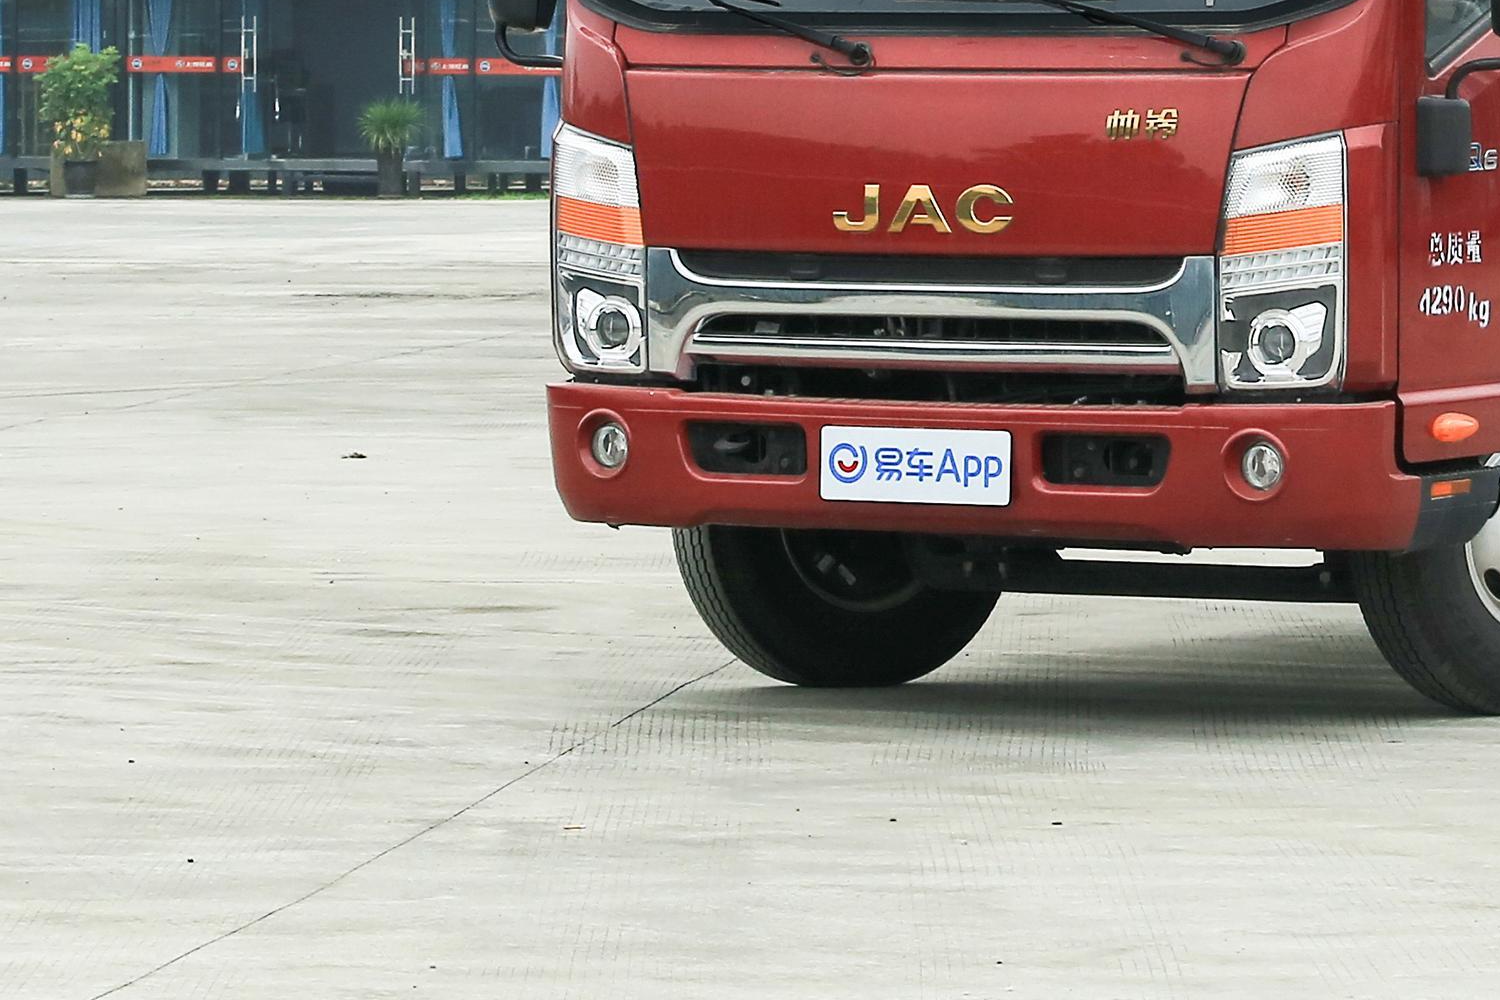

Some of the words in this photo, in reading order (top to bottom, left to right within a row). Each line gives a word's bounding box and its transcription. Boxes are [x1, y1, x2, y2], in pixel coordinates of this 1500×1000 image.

[1105, 107, 1179, 141] 帅铃
[832, 183, 1014, 234] JAC
[1428, 229, 1482, 267] 总质量
[1468, 291, 1491, 329] kg
[875, 447, 1003, 489] 易车App
